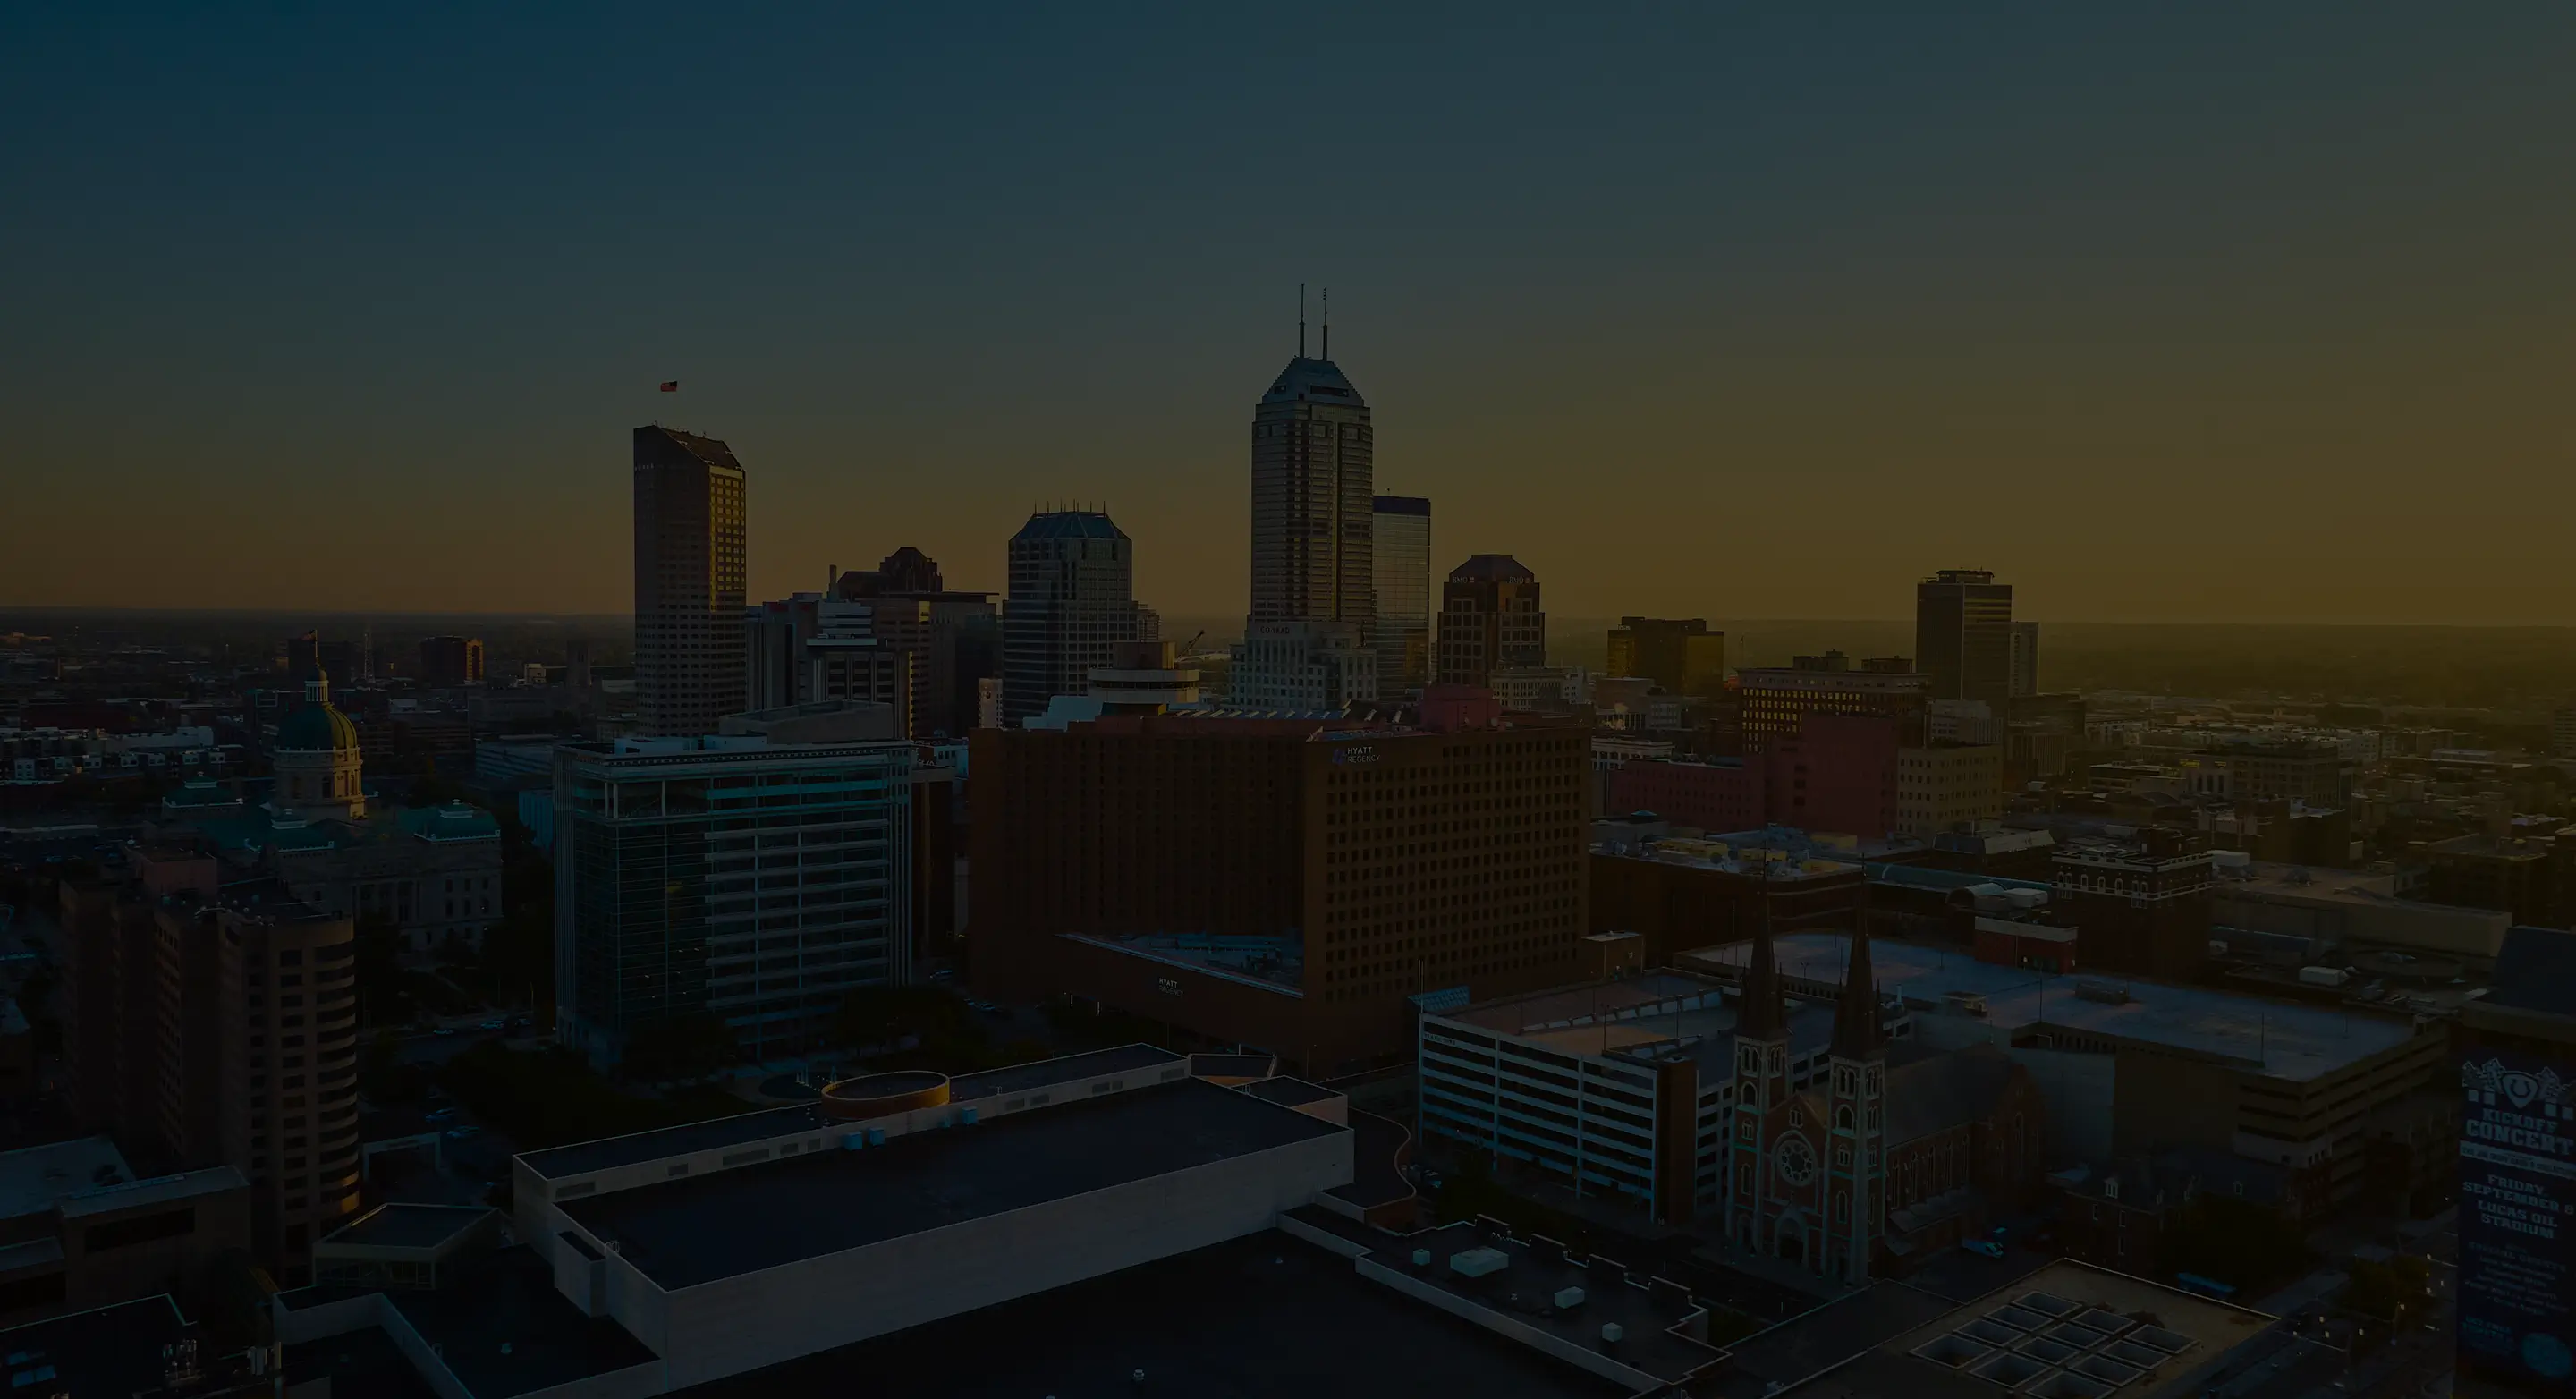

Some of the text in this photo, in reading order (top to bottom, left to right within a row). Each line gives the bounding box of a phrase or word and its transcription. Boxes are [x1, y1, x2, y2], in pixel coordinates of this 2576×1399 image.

[1347, 747, 1373, 755] HYATT
[1347, 755, 1380, 763] REGENCY
[1158, 977, 1178, 988] HYATT
[2482, 1108, 2558, 1133] KICKOFF
[2466, 1118, 2574, 1155] CONCERT
[2462, 1181, 2559, 1212] SEPTEMBER
[2477, 1200, 2558, 1228] LUCAS OIL
[2480, 1213, 2555, 1239] STADIUM
